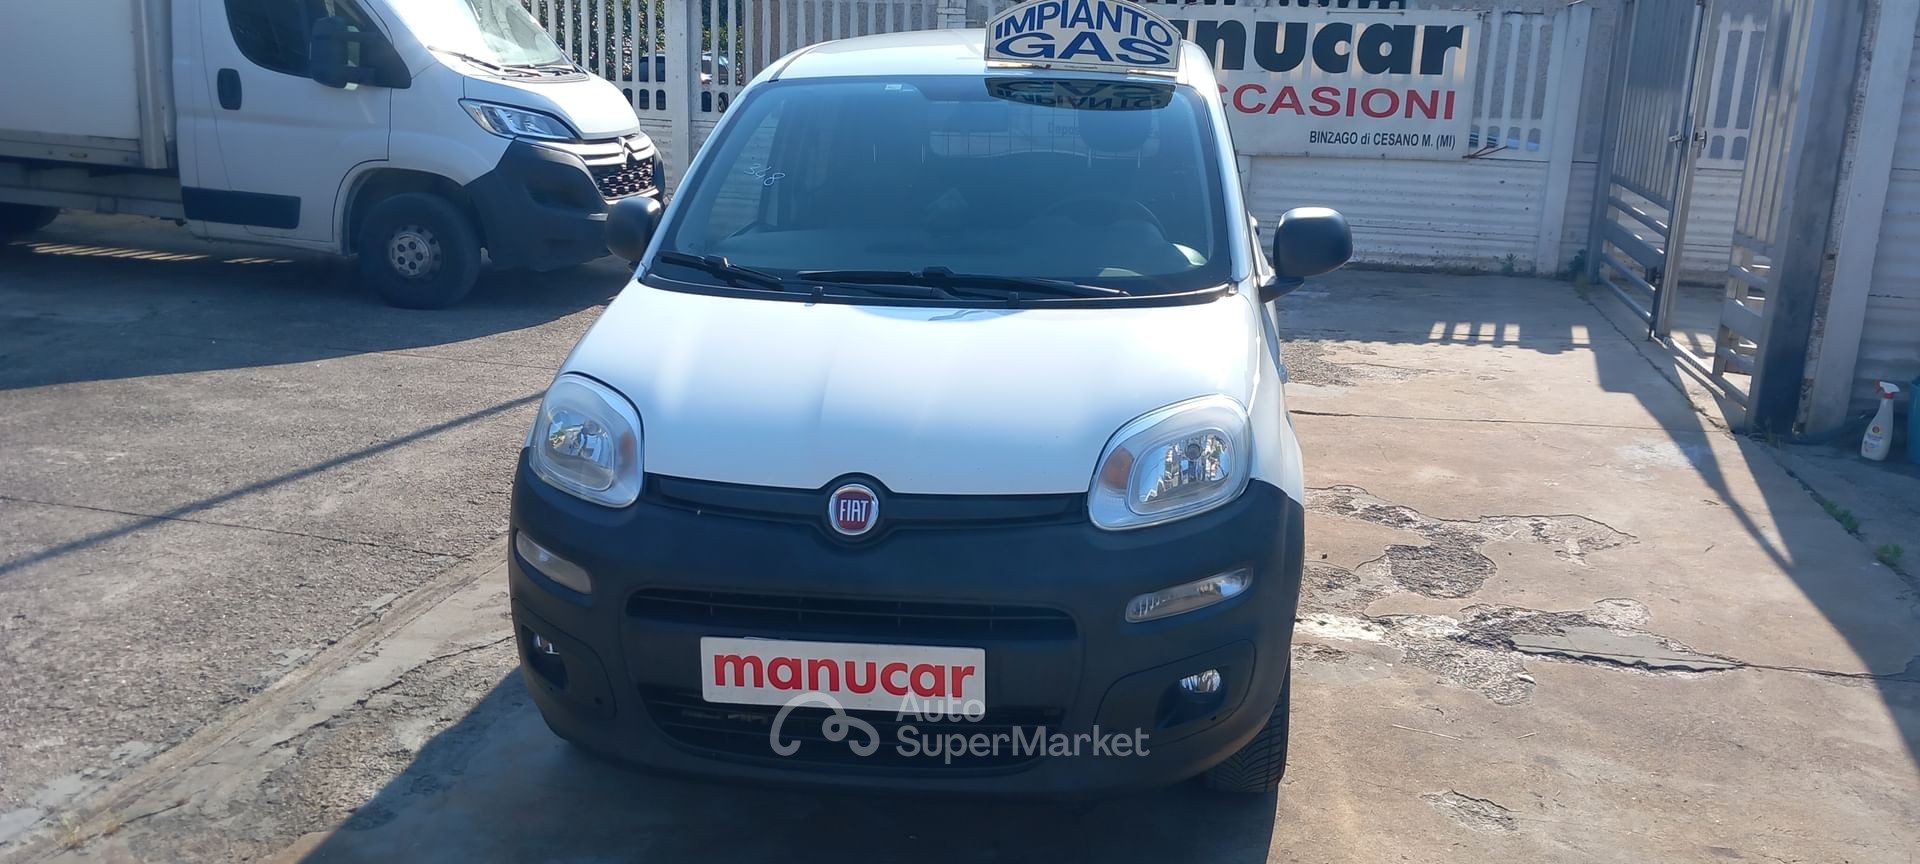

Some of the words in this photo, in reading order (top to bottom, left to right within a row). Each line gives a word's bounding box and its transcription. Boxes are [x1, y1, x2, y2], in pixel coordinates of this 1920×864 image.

[995, 0, 1173, 47] IMPIANTO
[995, 32, 1170, 65] GAS
[1309, 130, 1358, 145] BINZAGO
[1360, 132, 1371, 145] di
[1373, 132, 1419, 147] CESANO
[1422, 134, 1433, 147] M.
[1436, 134, 1456, 150] (MI)
[840, 499, 869, 522] FIAT
[713, 653, 975, 698] manucar
